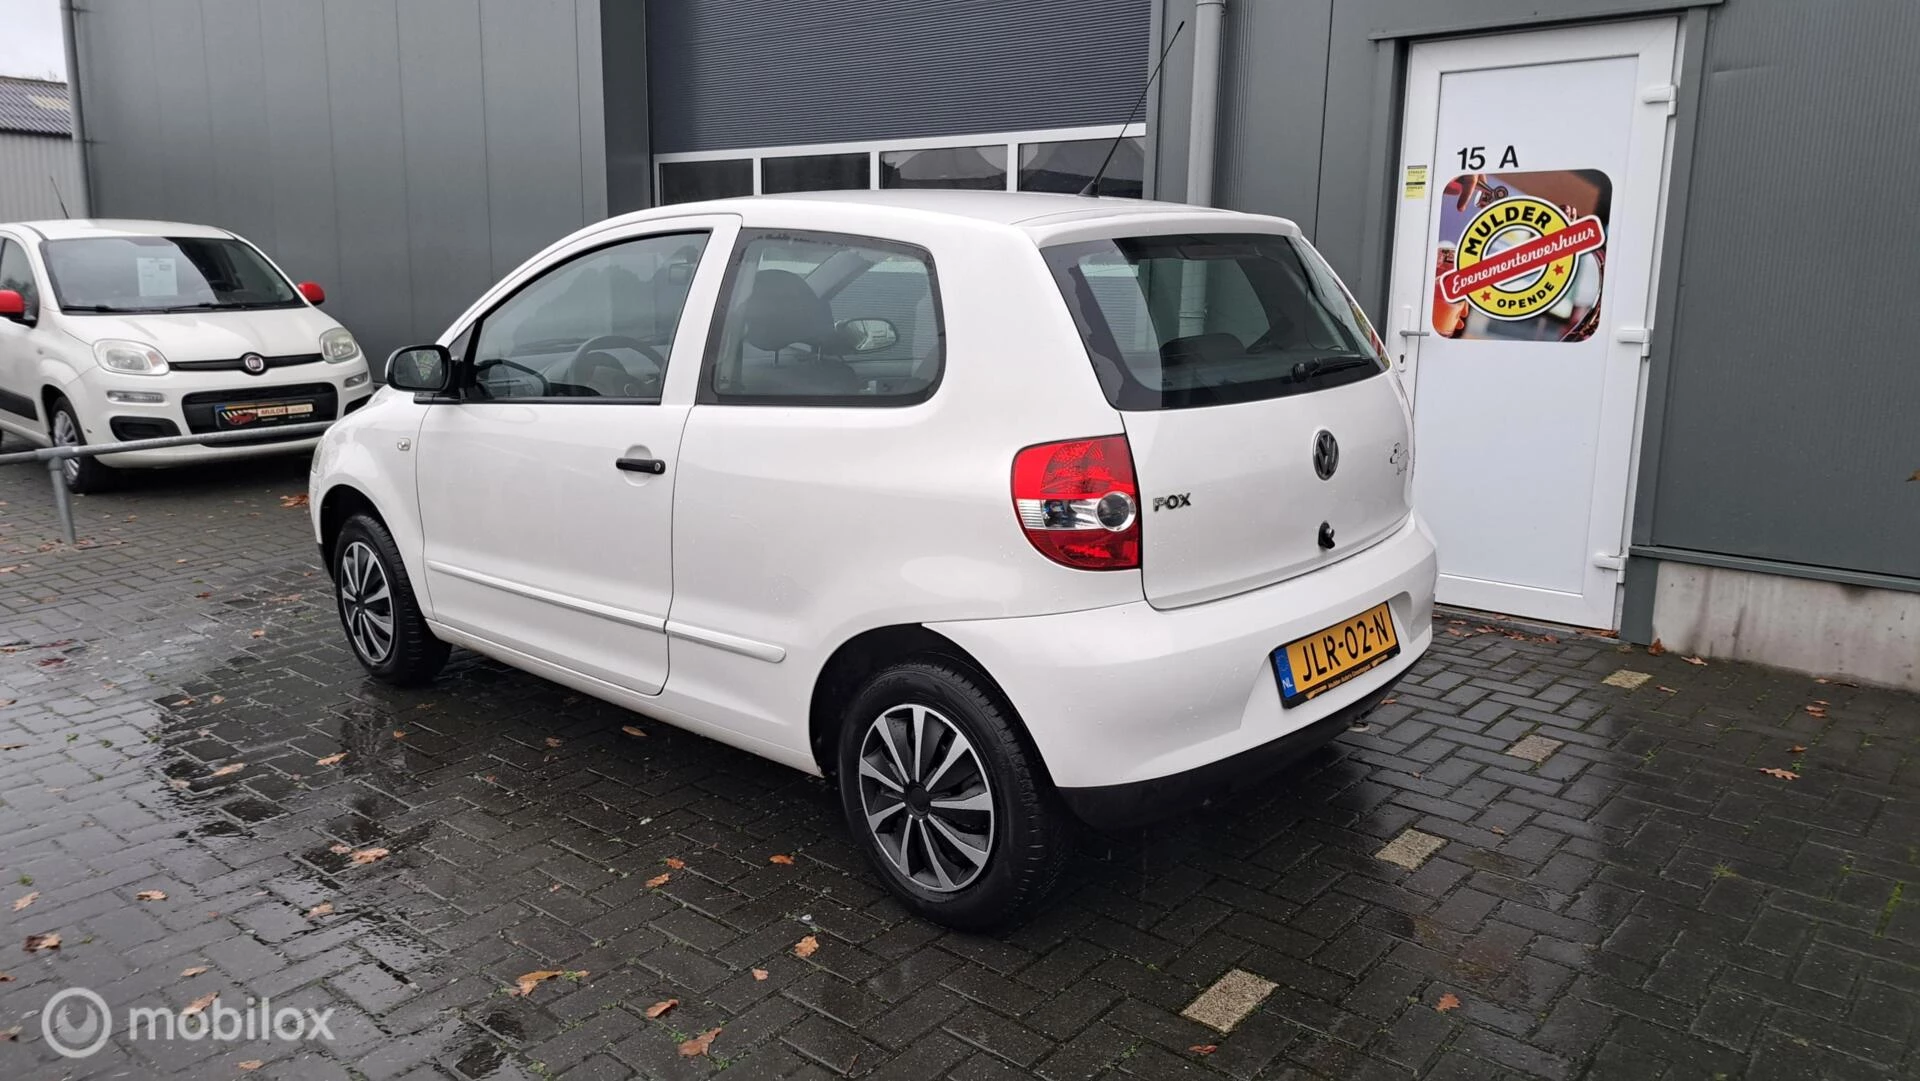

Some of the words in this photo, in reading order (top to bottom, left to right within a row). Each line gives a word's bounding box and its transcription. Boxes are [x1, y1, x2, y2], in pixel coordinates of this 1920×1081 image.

[1457, 147, 1485, 169] 15
[1499, 145, 1519, 168] A
[1465, 205, 1552, 256] MULDER
[1452, 226, 1595, 294] Evenementenverhuur
[1497, 281, 1555, 309] OPENDE
[1152, 492, 1191, 512] FOX
[1302, 611, 1389, 682] JLR-02-N
[1282, 677, 1293, 690] NL
